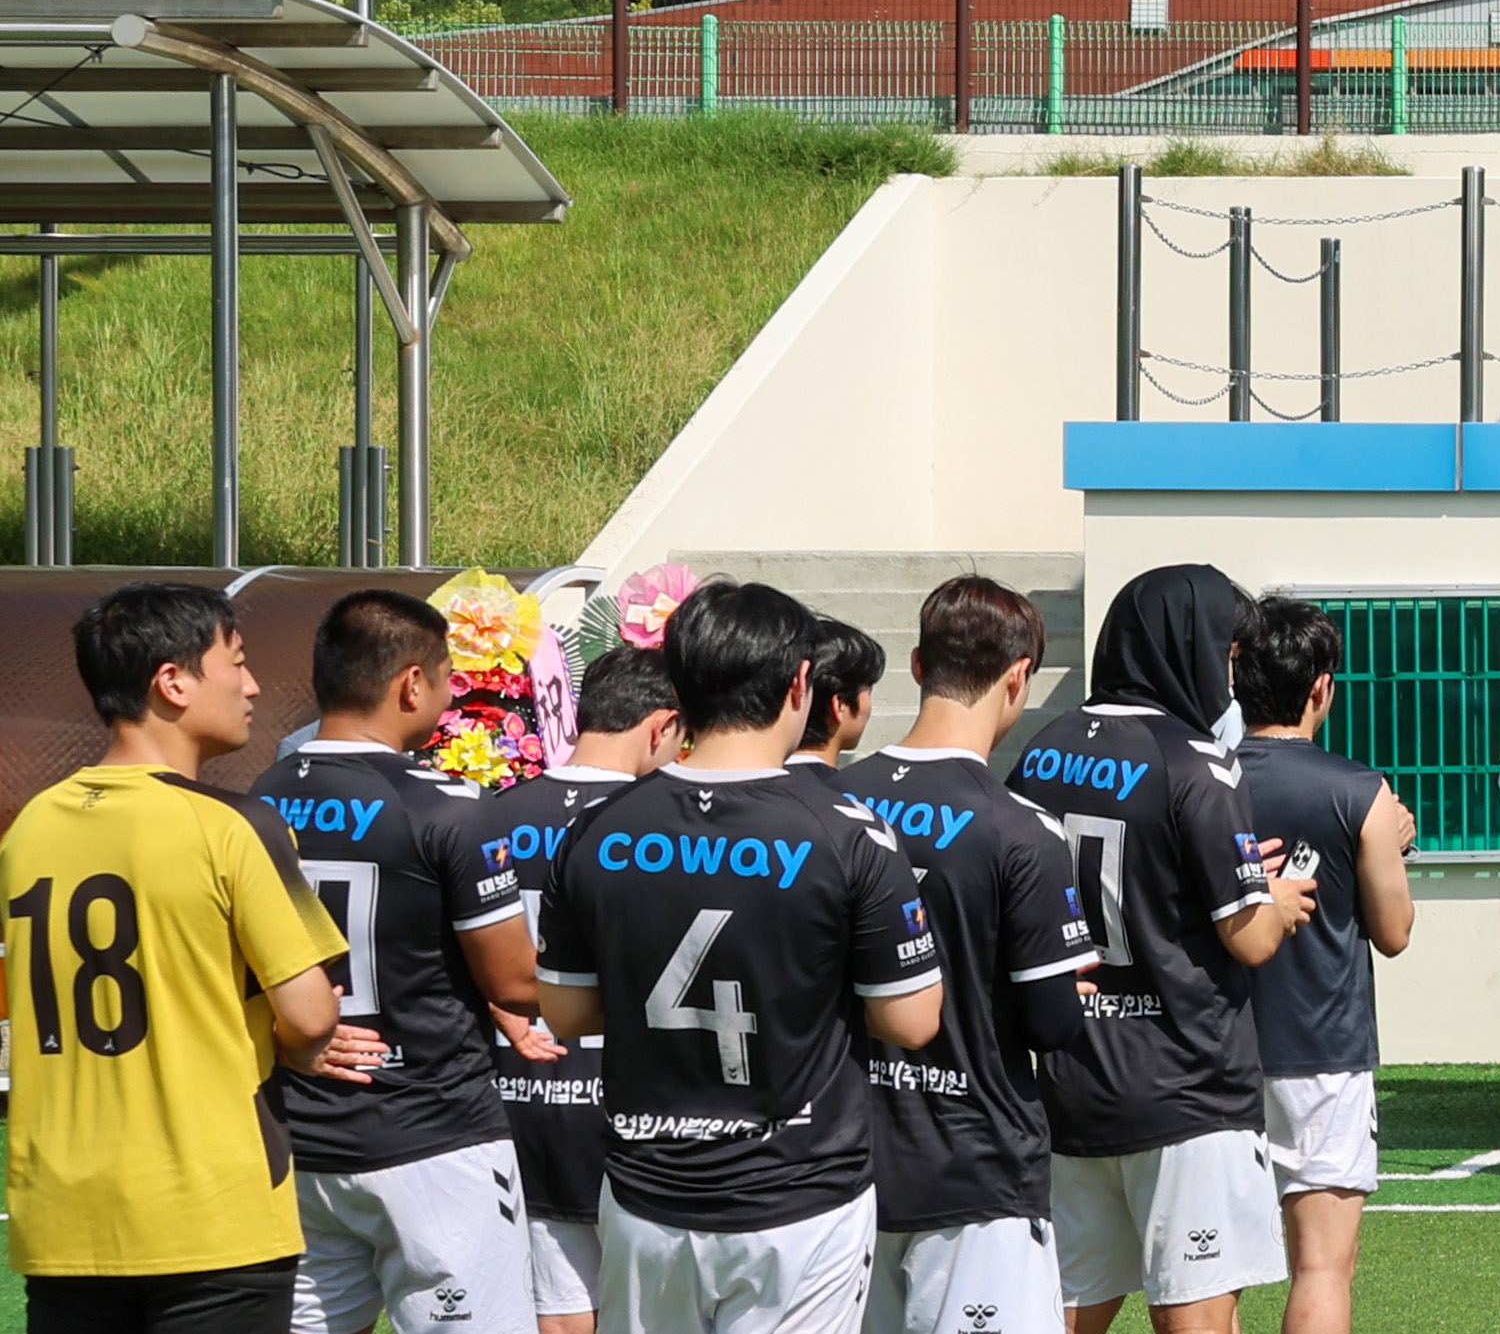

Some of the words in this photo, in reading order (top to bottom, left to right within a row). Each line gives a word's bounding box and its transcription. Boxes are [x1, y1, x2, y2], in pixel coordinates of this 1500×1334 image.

[1022, 747, 1149, 801] coway
[260, 795, 385, 841] way
[842, 792, 975, 849] way
[598, 832, 813, 889] coway
[8, 872, 149, 1057] 18
[645, 908, 758, 1086] 4
